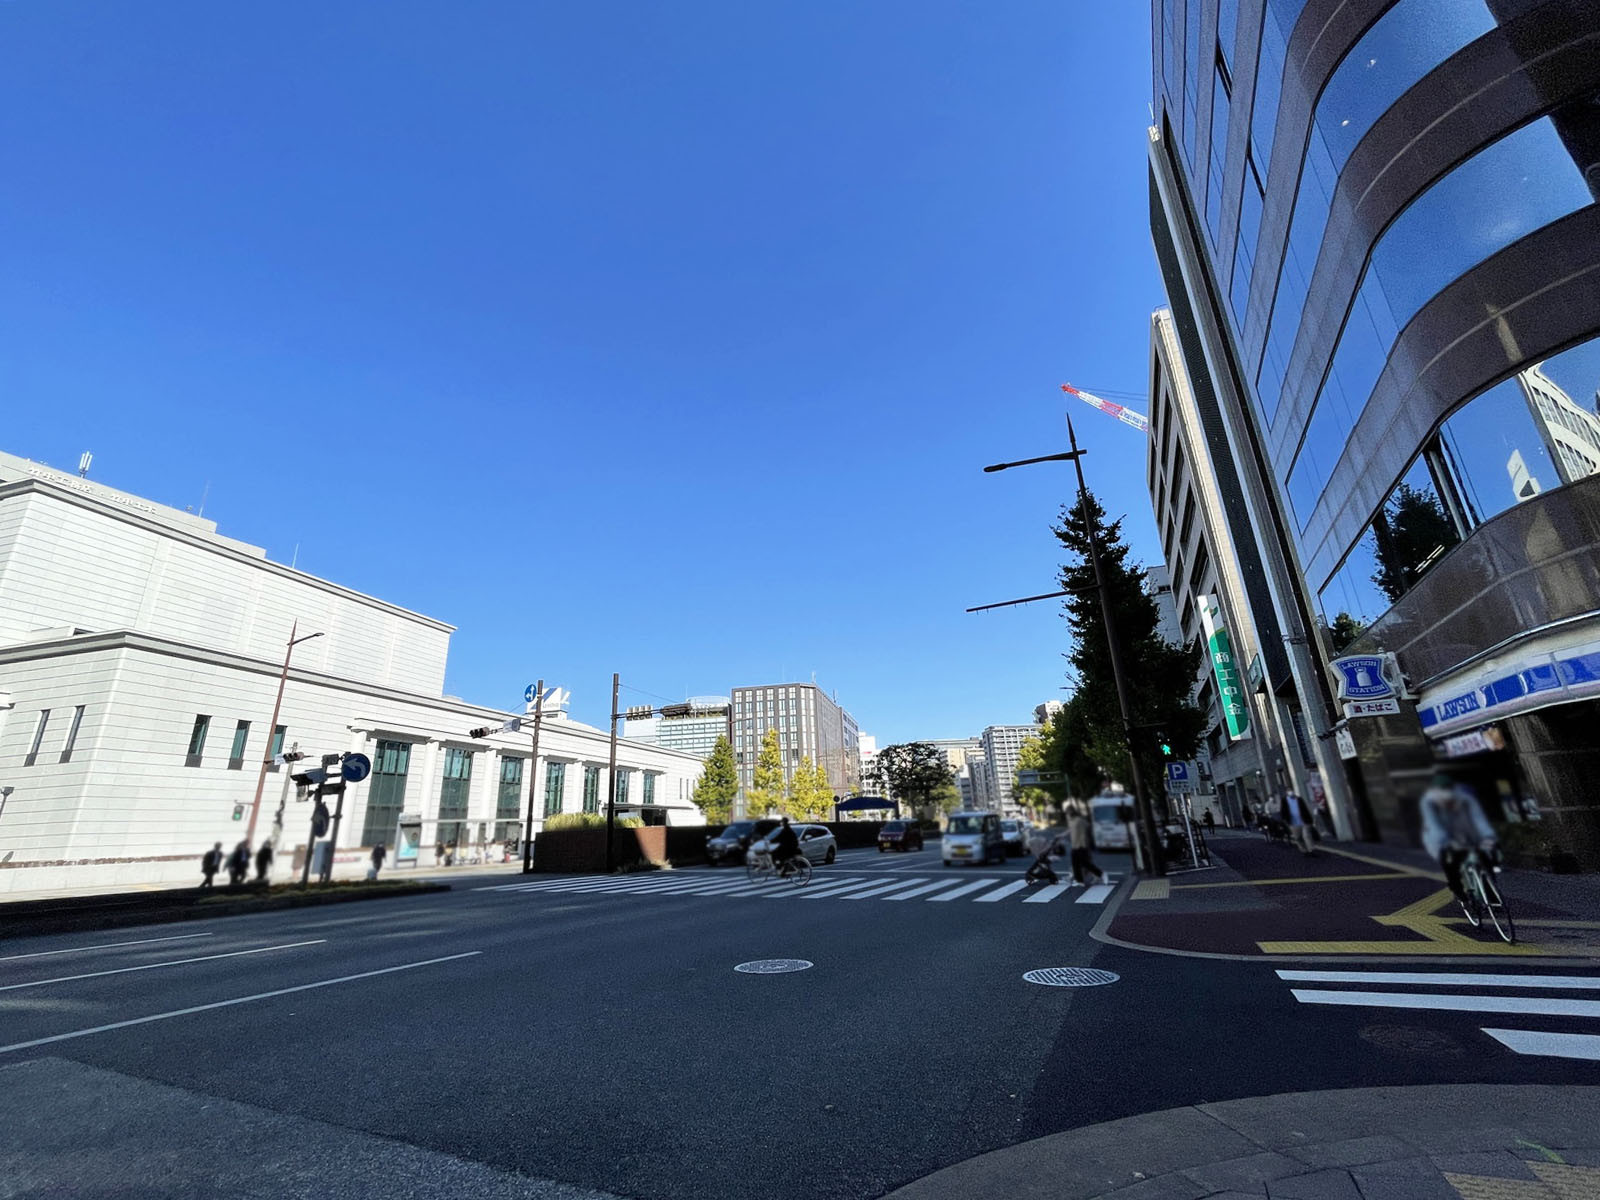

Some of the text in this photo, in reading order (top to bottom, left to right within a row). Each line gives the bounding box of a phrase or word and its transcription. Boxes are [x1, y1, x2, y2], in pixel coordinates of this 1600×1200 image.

[1342, 660, 1377, 670] LAWSON
[1214, 651, 1243, 716] 商工中金
[1348, 684, 1386, 693] STATION
[1437, 691, 1481, 721] LAWSON
[1171, 764, 1183, 779] P
